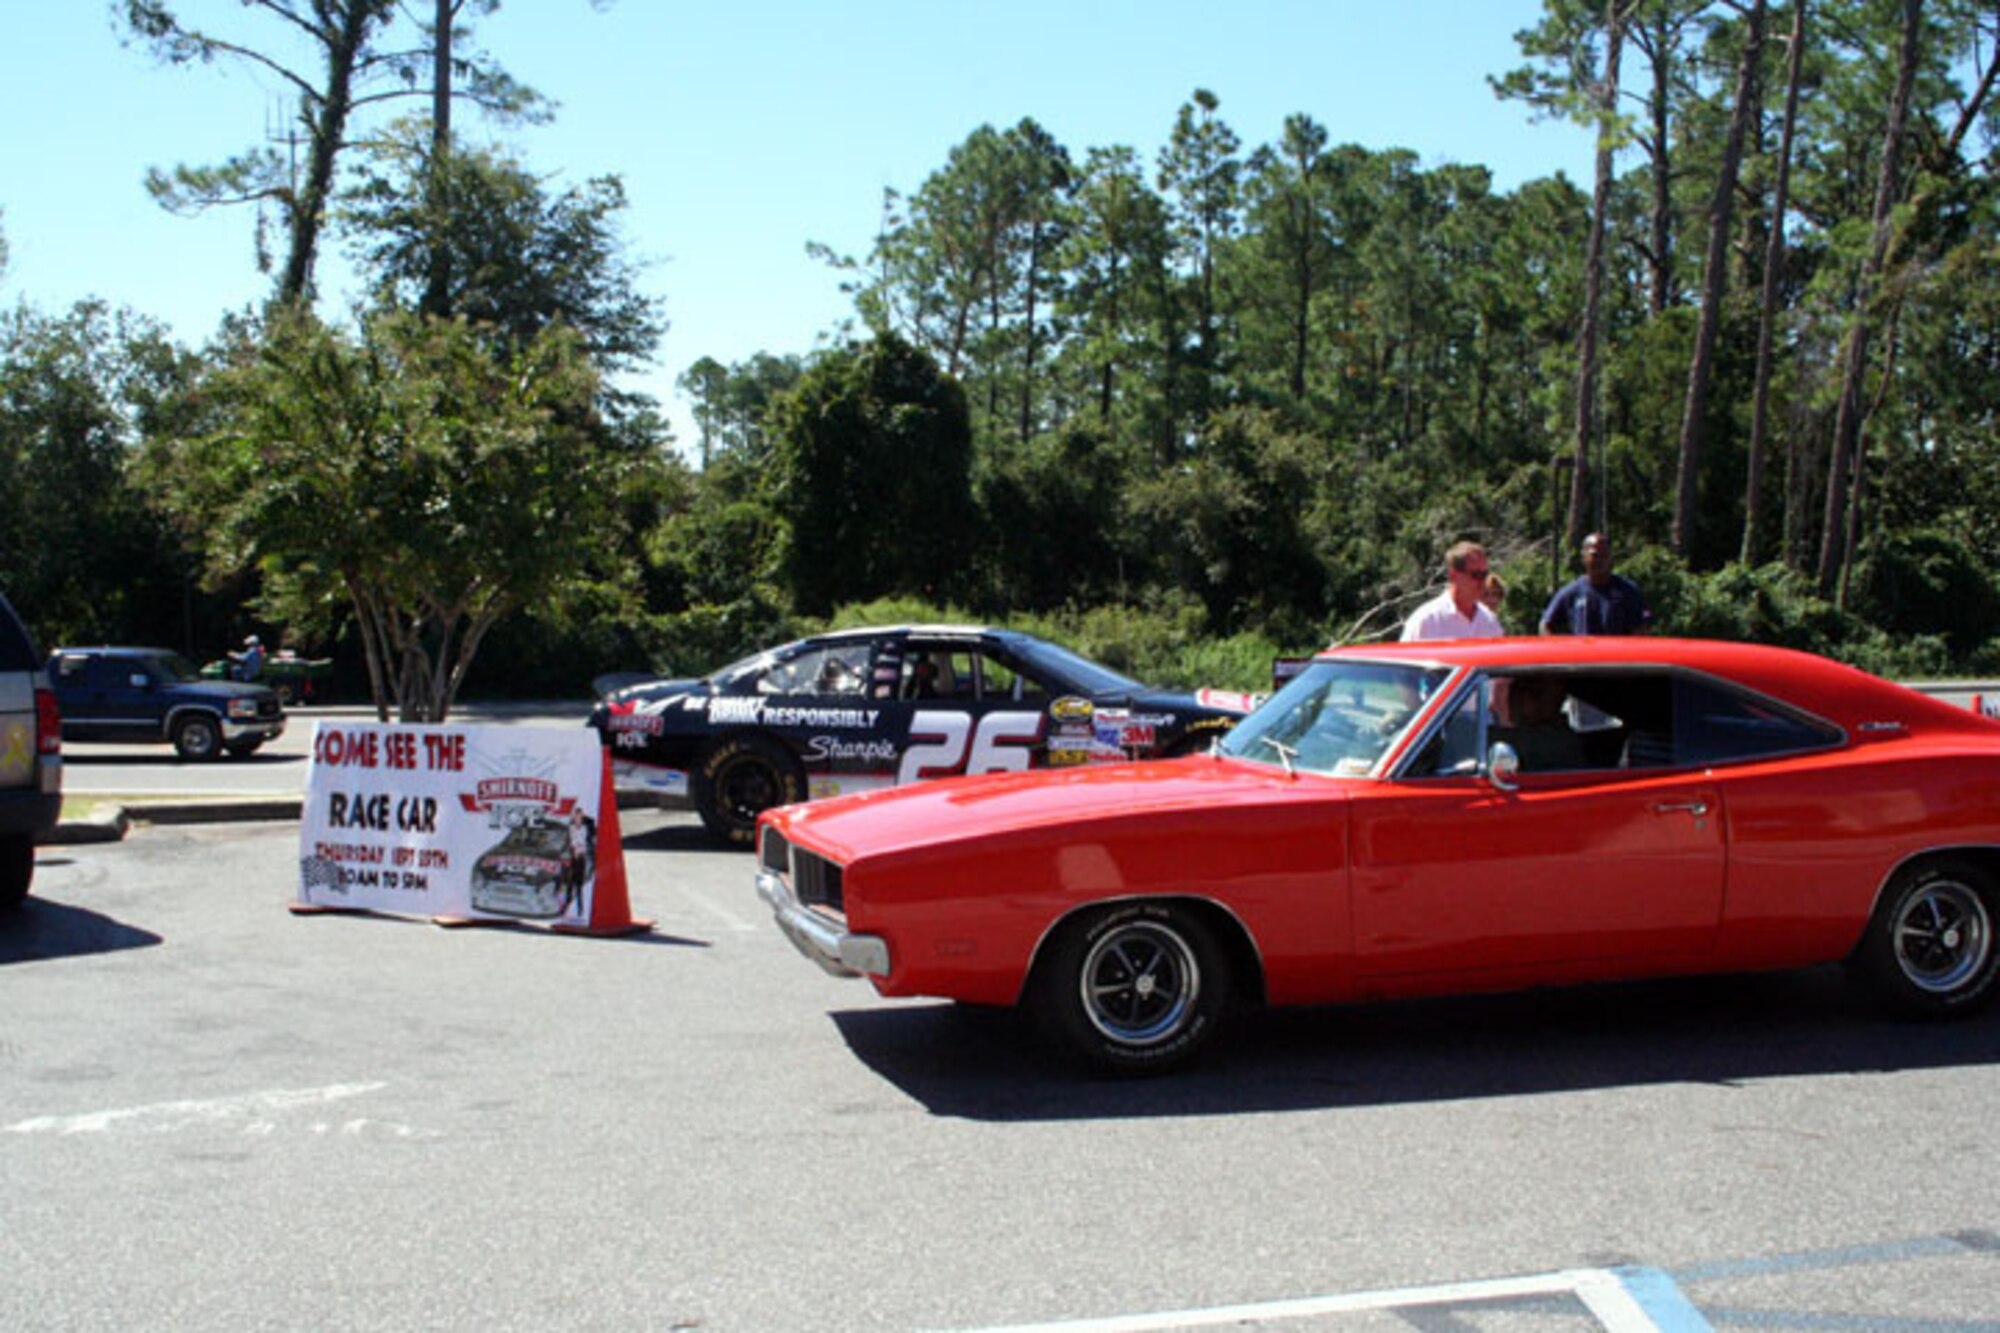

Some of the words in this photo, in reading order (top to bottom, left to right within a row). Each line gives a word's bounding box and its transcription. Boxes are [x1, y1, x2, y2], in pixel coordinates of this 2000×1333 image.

[763, 707, 880, 728] RESPONSIBLY
[1121, 725, 1155, 744] 3M
[314, 730, 379, 768] COME
[385, 732, 418, 769] SEE
[424, 733, 466, 771] THE
[801, 735, 898, 763] Sharpie
[897, 711, 1046, 787] 26
[329, 792, 390, 831] RACE
[396, 796, 438, 833] CAR
[382, 870, 399, 889] TO
